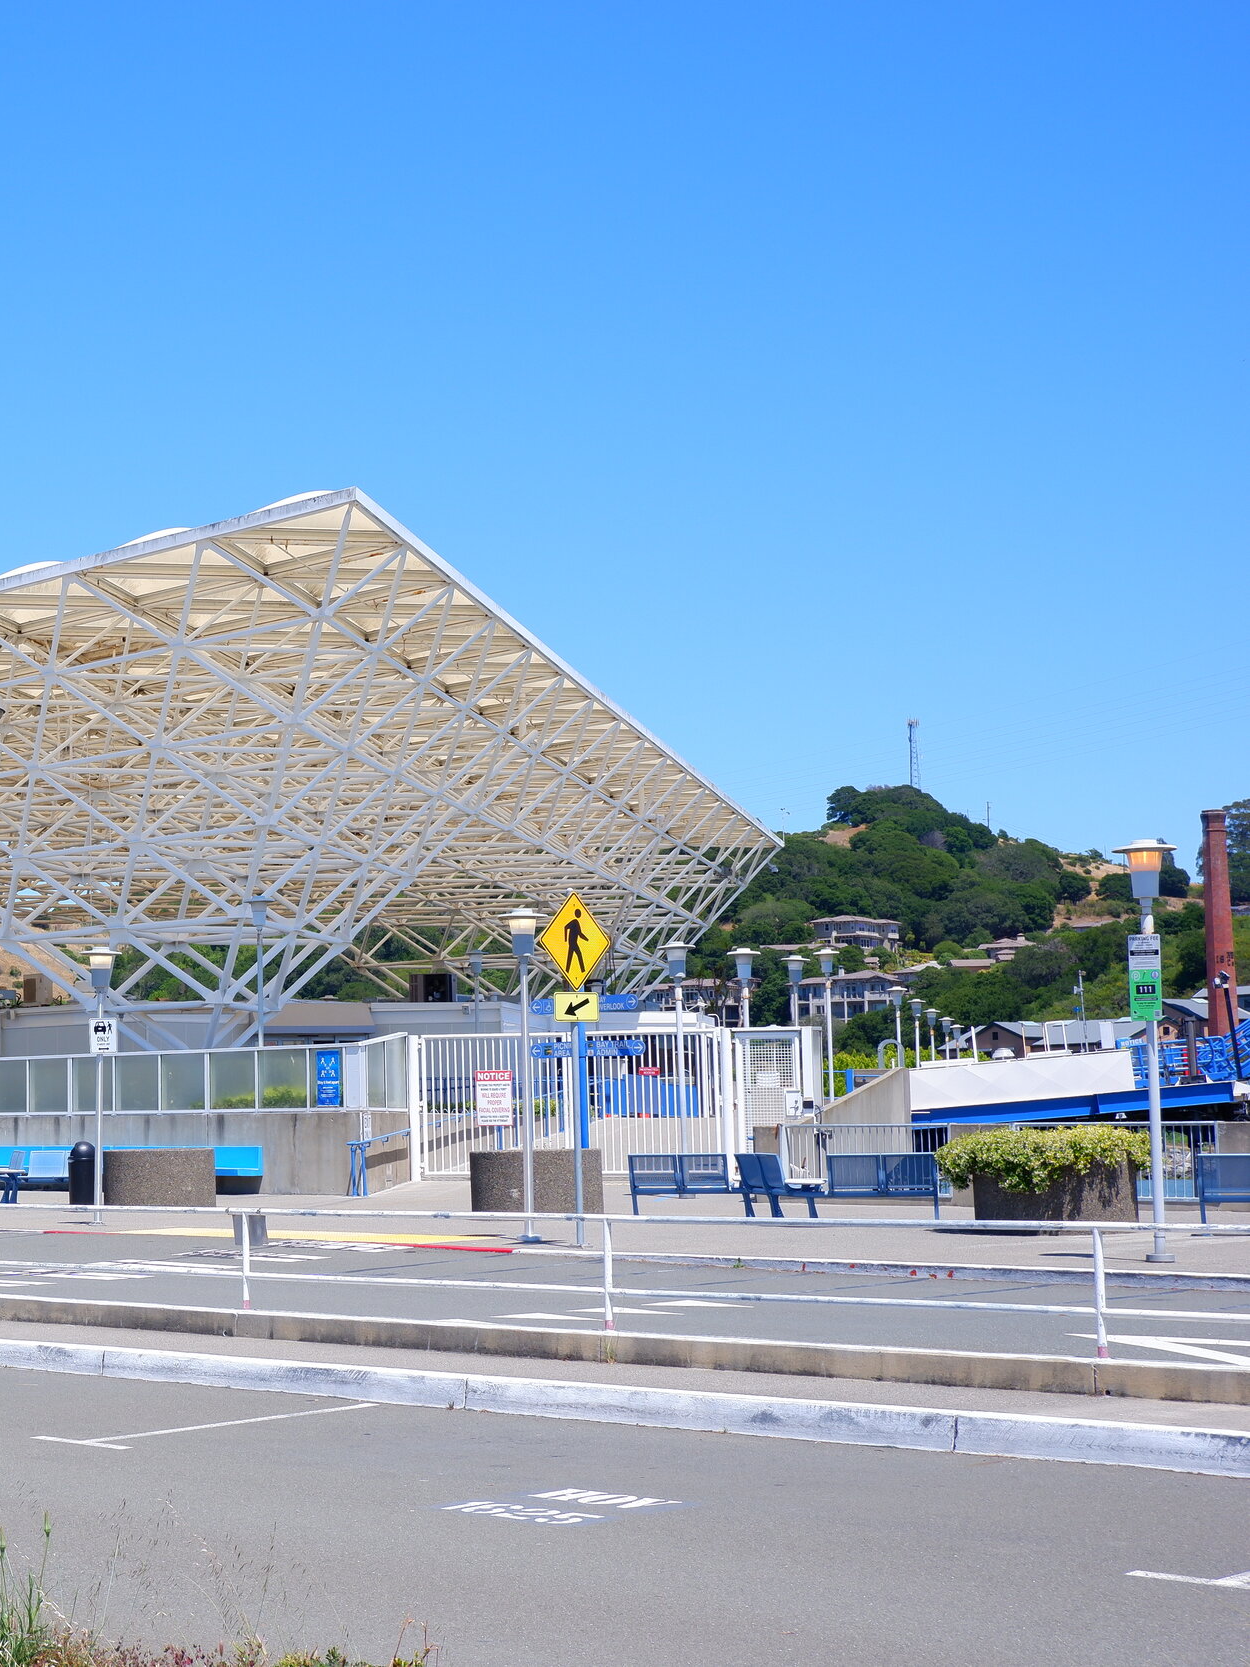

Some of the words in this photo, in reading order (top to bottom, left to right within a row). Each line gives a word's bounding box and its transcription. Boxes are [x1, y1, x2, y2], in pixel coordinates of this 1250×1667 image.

[611, 1040, 630, 1048] TRAIL
[477, 1072, 510, 1080] NOTICE
[527, 1488, 683, 1509] HOV
[440, 1501, 605, 1524] 1625
